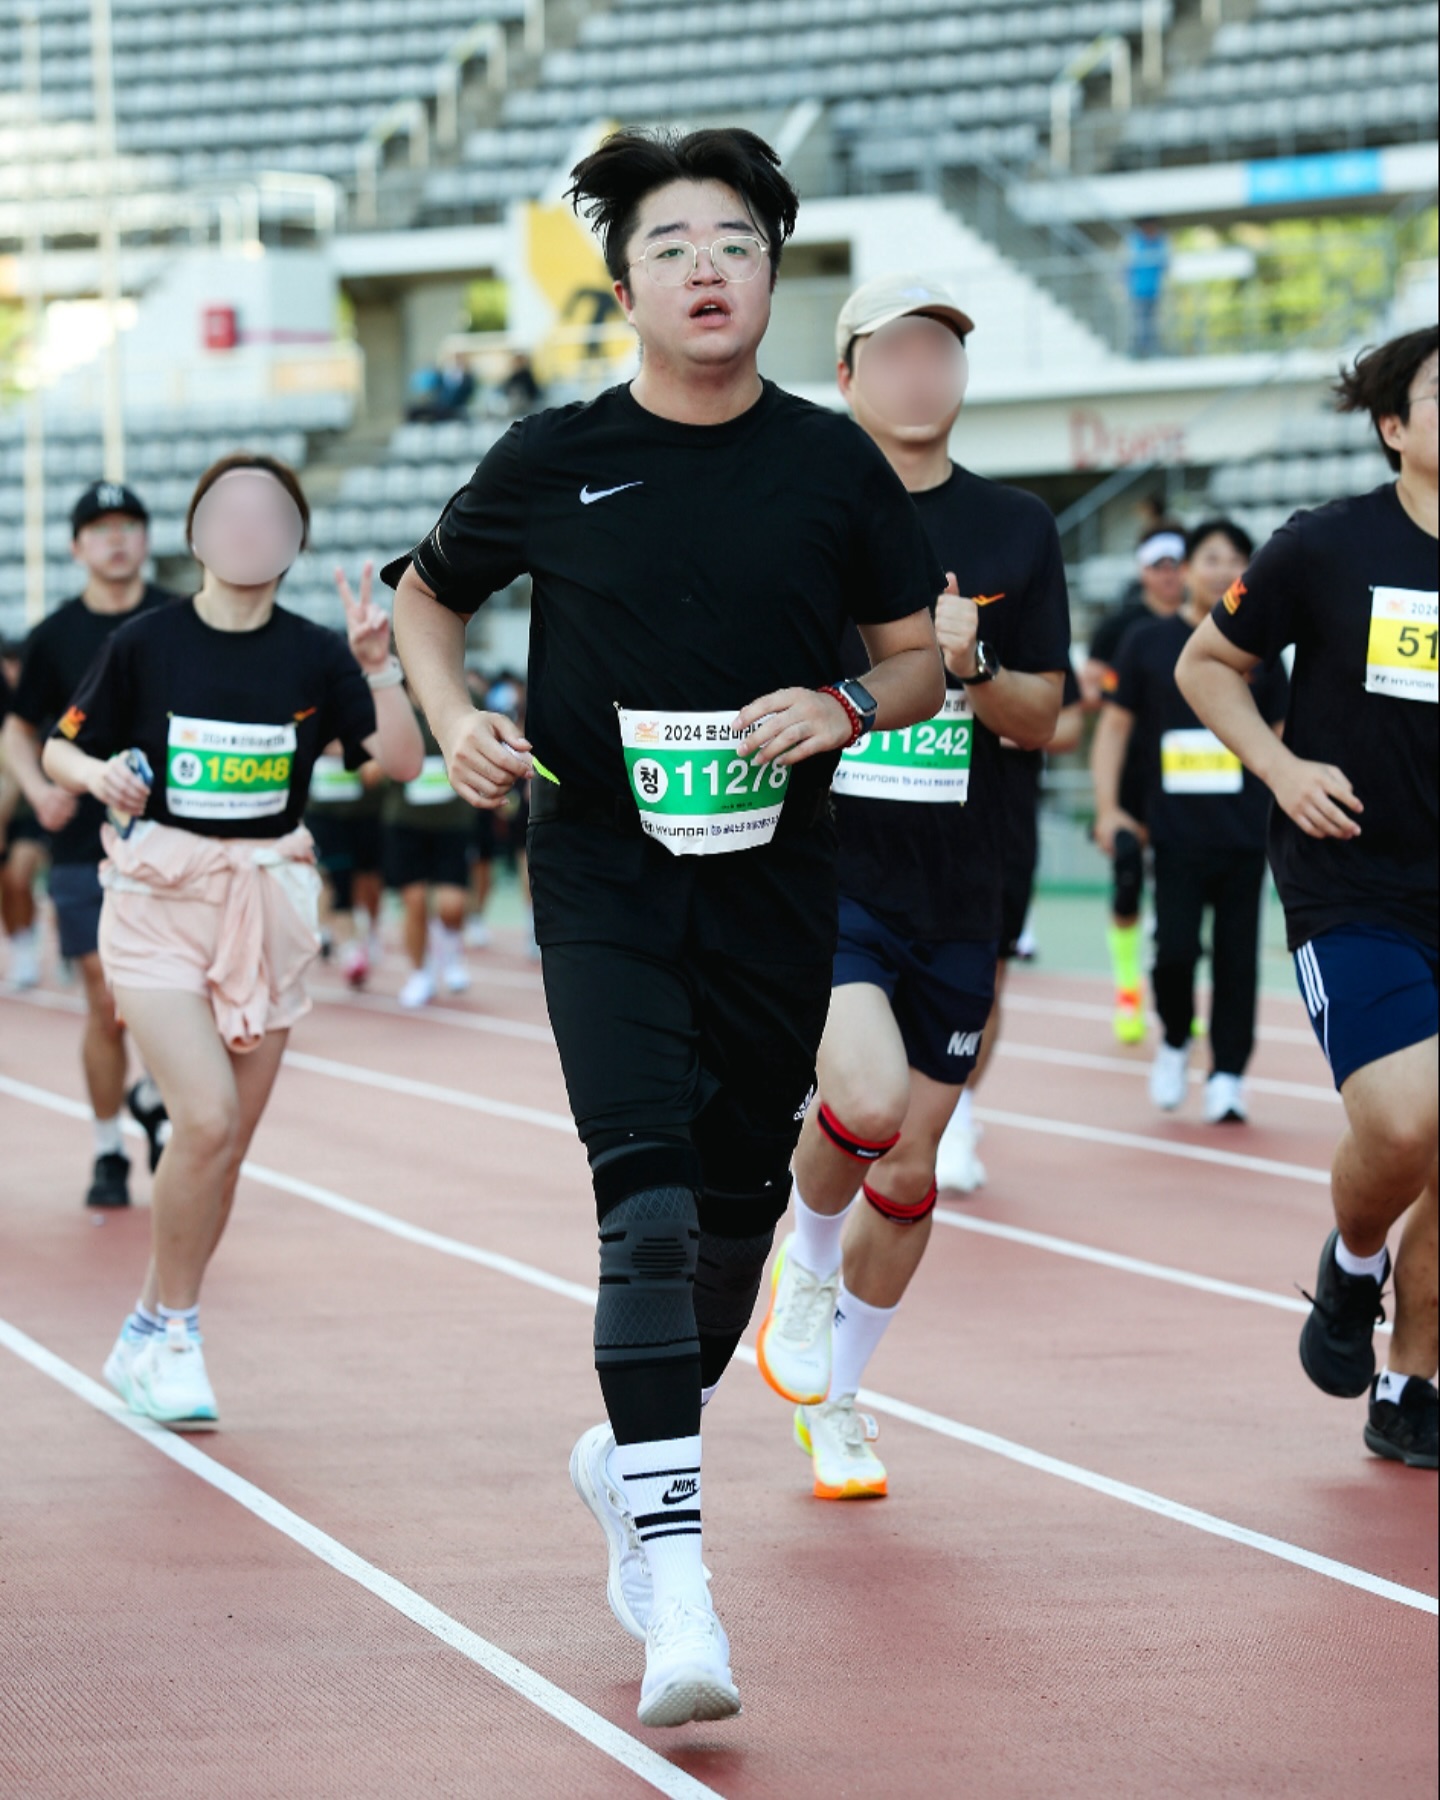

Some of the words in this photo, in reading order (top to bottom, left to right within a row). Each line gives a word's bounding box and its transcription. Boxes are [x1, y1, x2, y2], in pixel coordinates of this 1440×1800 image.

[1397, 626, 1438, 661] 51
[664, 724, 702, 741] 2024
[878, 724, 969, 756] 11242
[206, 756, 290, 783] 15048
[640, 765, 658, 795] 청
[674, 756, 788, 796] 11278
[655, 823, 709, 837] HYUNDAI
[671, 1478, 697, 1492] NIKE
